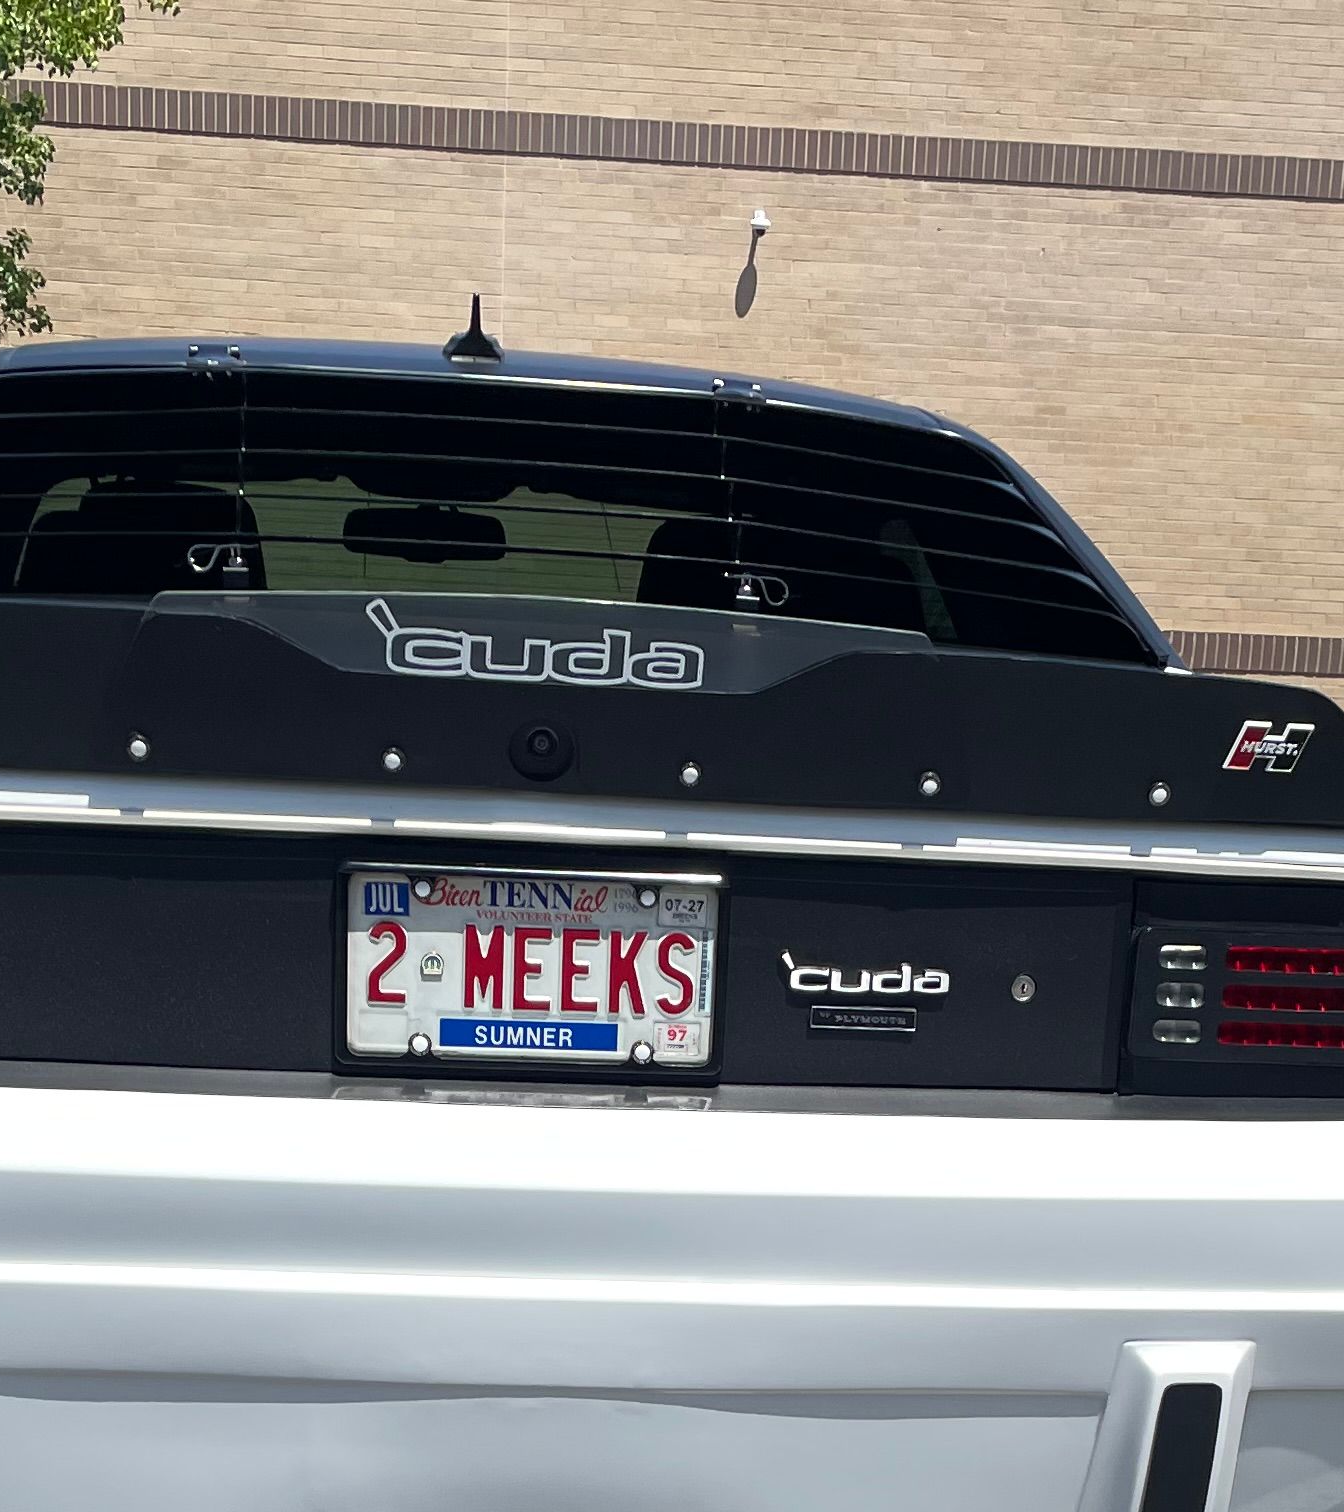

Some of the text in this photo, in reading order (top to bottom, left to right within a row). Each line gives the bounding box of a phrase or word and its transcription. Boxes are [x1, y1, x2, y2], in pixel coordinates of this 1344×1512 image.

[369, 883, 404, 912] JUL
[665, 898, 704, 912] 07-27
[476, 909, 593, 924] VOLUNTEER STATE
[367, 921, 696, 1016] 2 MEEKS
[474, 1024, 573, 1048] SUMNER
[667, 1029, 687, 1041] 97
